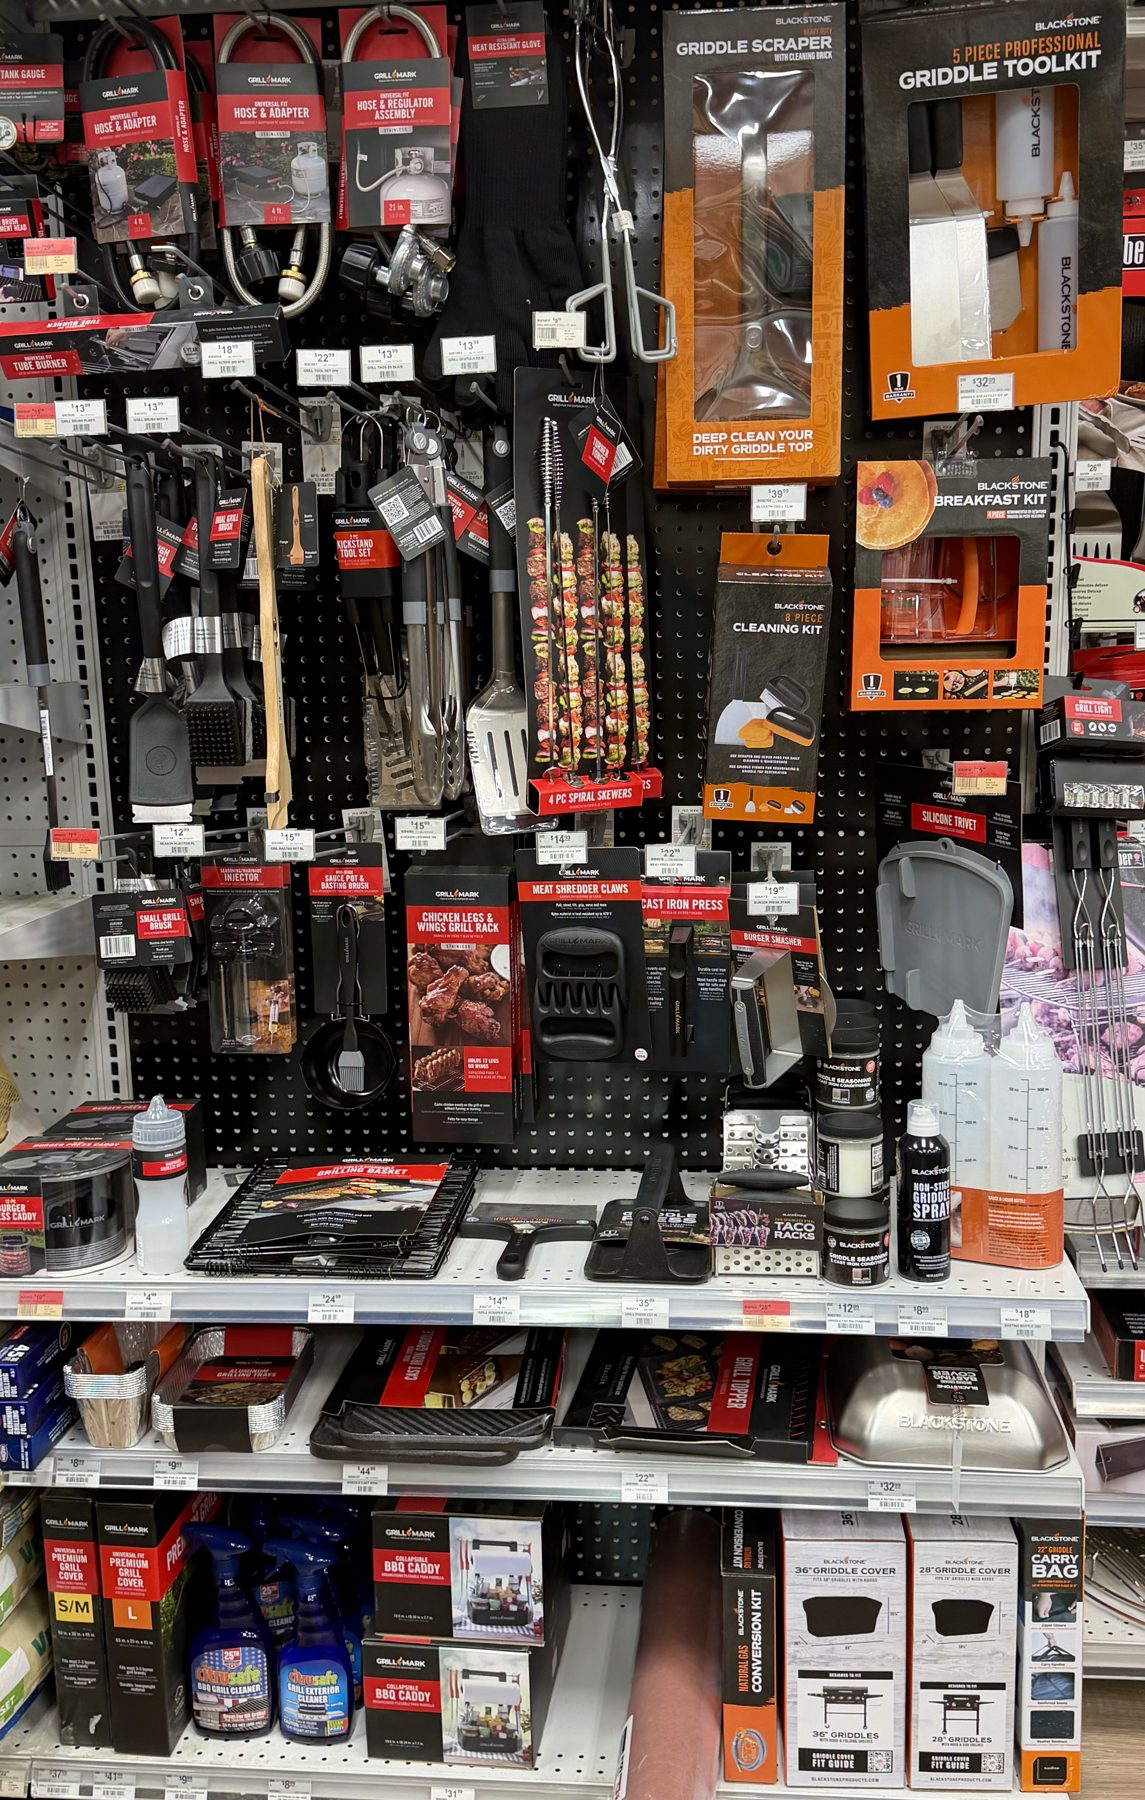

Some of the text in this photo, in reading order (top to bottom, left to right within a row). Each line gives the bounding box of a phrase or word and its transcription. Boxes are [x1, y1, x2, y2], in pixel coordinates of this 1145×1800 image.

[775, 16, 832, 25] BLACKSTONE
[1035, 15, 1101, 31] BLACKSTONE
[472, 39, 541, 52] HEAT RESISTANT GLOVE
[676, 36, 832, 57] GRIDDLE SCRAPER
[953, 31, 1101, 64] 5 PIECE PROFESSIONAL
[774, 51, 833, 62] WITH CLEANING BRICK
[1, 69, 46, 79] TANK GAUGE
[899, 50, 1102, 90] GRIDDLE TOOLKIT
[357, 98, 433, 111] HOSE & REGULATOR
[234, 107, 310, 119] HOSE & ADAPTER
[374, 108, 416, 120] ASSEMBLY
[94, 115, 157, 135] HOSE & ADAPTER
[1061, 257, 1071, 350] BLACKSTONE
[13, 359, 68, 371] TUBE BURNER
[548, 394, 596, 404] GRILL MARK
[693, 430, 814, 444] DEEP CLEAN YOUR
[693, 442, 814, 456] DIRTY GRIDDLE TOP
[977, 481, 1047, 491] BLACKSTONE
[934, 493, 1047, 507] BREAKFAST KIT
[218, 523, 233, 532] BRUSH
[337, 540, 373, 550] KICKSTAND
[341, 548, 371, 558] TOOL SET
[774, 603, 825, 611] BLACKSTONE
[785, 612, 823, 623] 8 PIECE
[733, 623, 823, 635] CLEANING KIT
[1075, 703, 1113, 714] GRILL LIGHT
[549, 788, 633, 804] 4 PC SPIRAL SKEWERS
[922, 811, 953, 826] SILICONE
[954, 816, 977, 831] TRIVET
[224, 873, 259, 882] INJECTOR
[321, 882, 369, 890] BASTING BRUSH
[532, 883, 628, 894] MEAT SHREDDER CLAWS
[642, 899, 723, 911] CAST IRON PRESS
[140, 913, 181, 923] SMALL GRILL
[422, 912, 493, 924] CHICKEN LEGS &
[150, 921, 172, 930] BRUSH
[417, 922, 499, 933] WINGS GRILL RACK
[743, 932, 802, 947] BURGER SMASHER
[823, 1063, 861, 1072] BLACKSTONE
[913, 1189, 950, 1203] GRIDDLE
[913, 1202, 950, 1219] SPRAY
[13, 1212, 37, 1221] CADDY
[774, 1221, 815, 1232] TACO
[774, 1231, 815, 1240] RACKS
[839, 1240, 881, 1249] BLACKSTONE
[726, 1357, 754, 1409] GRILL TOPPER
[898, 1415, 1011, 1434] BLACKSTONE
[45, 1518, 89, 1528] GRILL MARK
[412, 1530, 435, 1538] MARK
[52, 1553, 87, 1564] PREMIUM
[109, 1558, 148, 1569] PREMIUM
[1031, 1554, 1079, 1564] CARRY
[59, 1563, 82, 1572] GRILL
[118, 1568, 141, 1578] GRILL
[384, 1562, 441, 1575] BBQ CADDY
[813, 1567, 858, 1575] GRIDDLE
[860, 1567, 896, 1575] COVER
[935, 1567, 976, 1575] GRIDDLE
[979, 1567, 1011, 1575] COVER
[1032, 1565, 1079, 1579] BAG
[59, 1571, 84, 1581] COVER
[117, 1577, 144, 1588] COVER
[58, 1600, 90, 1614] S/M
[127, 1606, 138, 1620] L
[751, 1589, 762, 1693] CONVERSION KIT
[738, 1644, 749, 1692] NATURAL GAS
[195, 1663, 261, 1685] citrusafe
[288, 1668, 339, 1686] citrusafe
[198, 1683, 261, 1694] BBQ GRILL CLEANER
[288, 1684, 340, 1695] GRILL EXTERIOR
[386, 1683, 418, 1691] COLLAPSIBLE
[298, 1695, 328, 1704] CLEANER
[375, 1688, 431, 1702] BBQ CADDY
[812, 1759, 855, 1769] FIT GUIDE
[931, 1761, 970, 1770] FIT GUIDE
